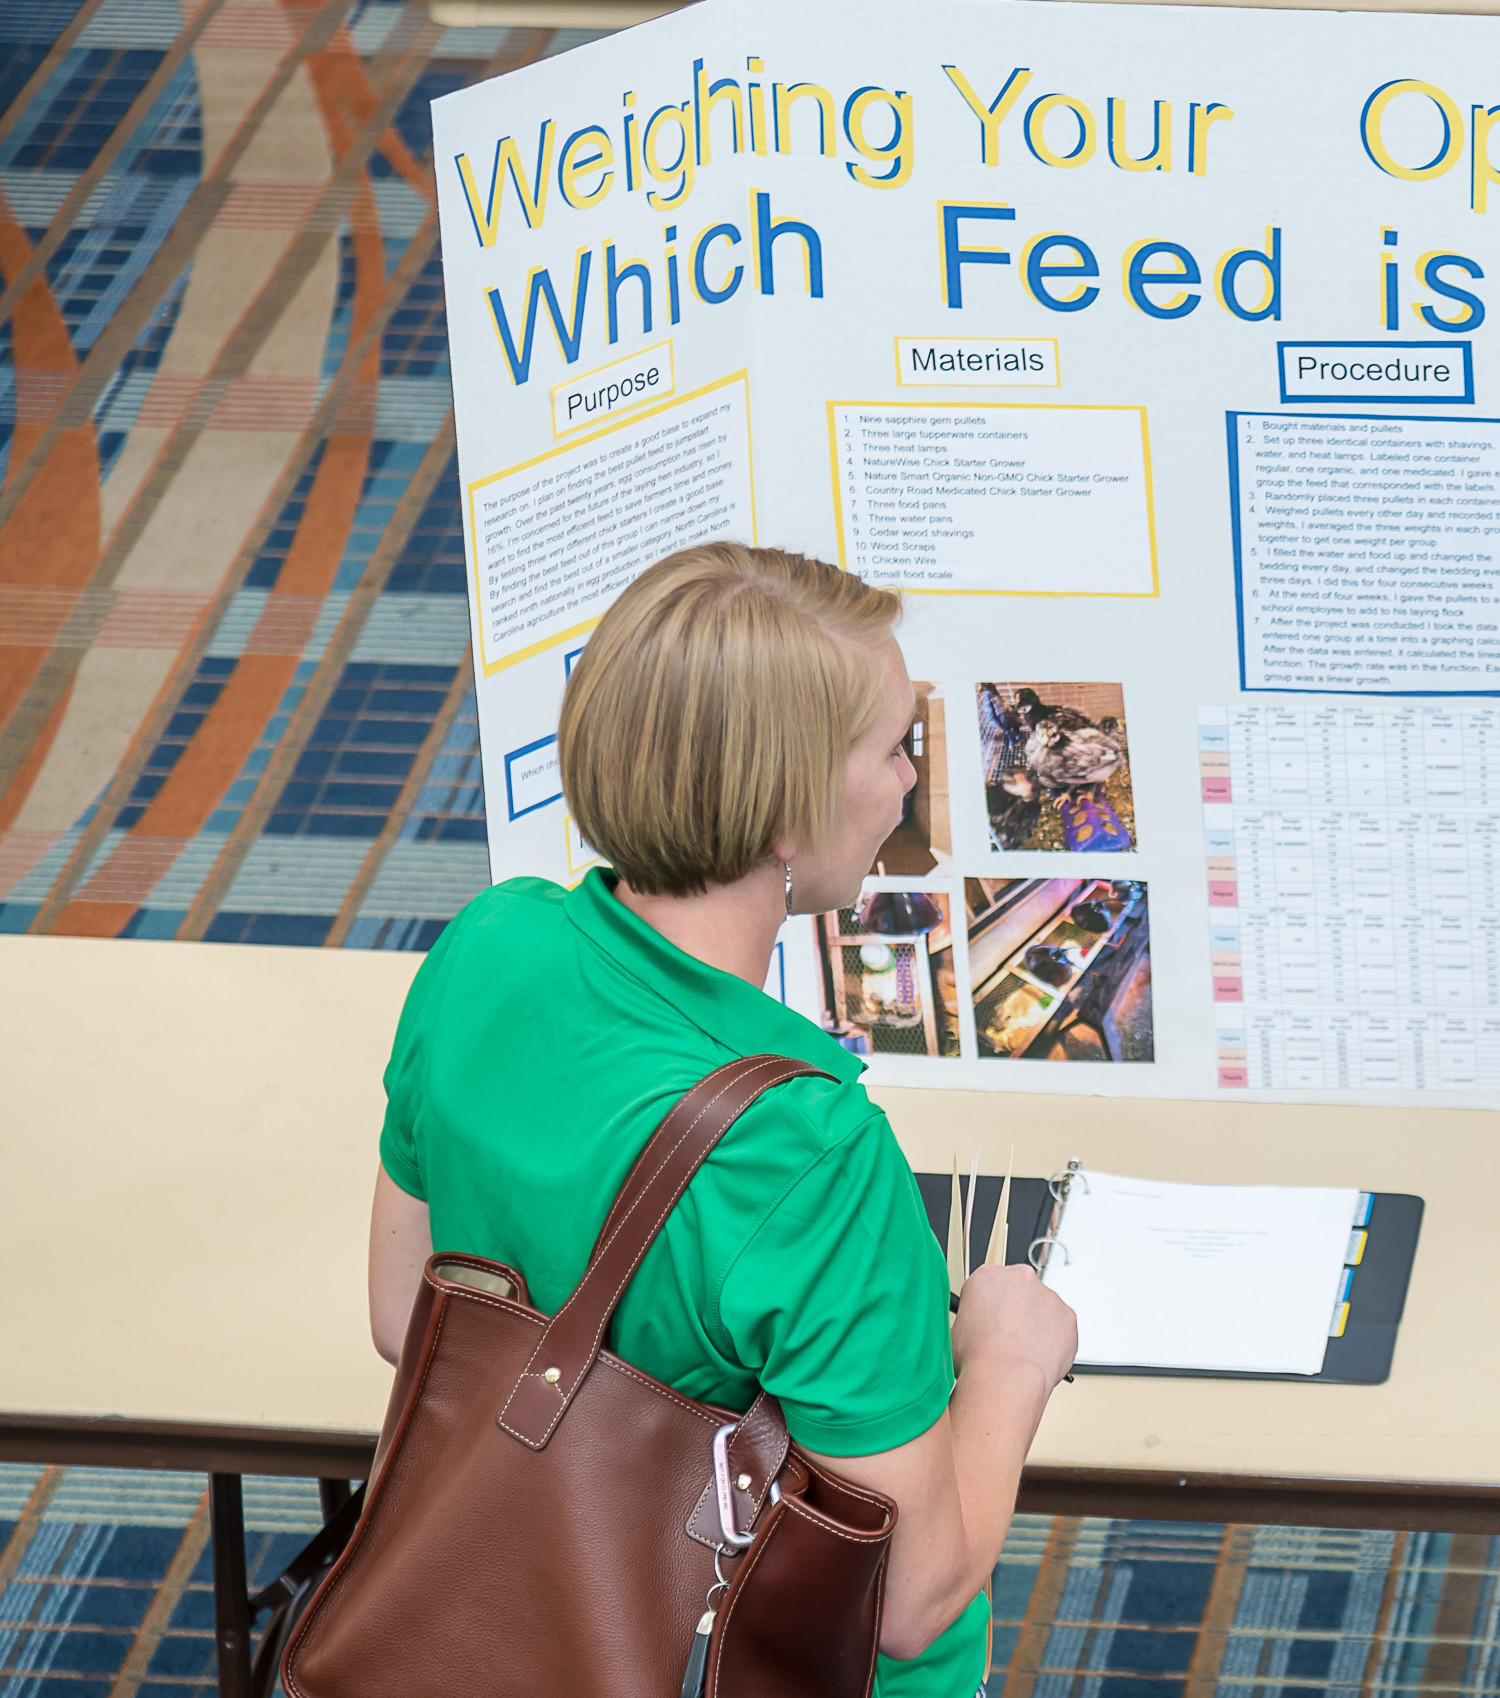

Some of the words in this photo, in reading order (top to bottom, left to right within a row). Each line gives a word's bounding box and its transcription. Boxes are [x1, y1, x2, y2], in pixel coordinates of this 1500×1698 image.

[454, 57, 913, 248] Weighing
[943, 65, 1234, 176] Your
[483, 188, 824, 385] Which
[937, 200, 1283, 321] Feed
[1379, 226, 1487, 333] is
[912, 348, 1045, 373] Materials
[1297, 356, 1451, 383] Procedure
[568, 367, 660, 420] Purpose
[859, 415, 882, 424] Nine
[884, 415, 927, 426] sapphire
[929, 417, 951, 426] gem
[953, 416, 986, 426] pullets
[1262, 420, 1298, 432] Bought
[1300, 422, 1346, 432] materials
[1348, 423, 1368, 432] and
[1370, 424, 1403, 434] pullets
[860, 428, 889, 438] Three
[892, 429, 917, 440] large
[919, 430, 974, 440] tupperware
[976, 431, 1028, 439] containers
[1262, 434, 1280, 444] Set
[1282, 437, 1295, 446] up
[1297, 436, 1323, 445] three
[1326, 437, 1368, 446] identical
[1370, 439, 1422, 448] containers
[1424, 440, 1445, 448] with
[861, 442, 890, 452] Three
[893, 443, 915, 452] heat
[916, 443, 947, 455] lamps
[482, 500, 498, 512] The
[499, 486, 530, 508] purpose
[541, 477, 554, 488] the
[555, 463, 581, 483] project
[582, 458, 598, 470] was
[608, 444, 632, 459] create
[640, 430, 660, 448] good
[661, 424, 680, 437] base
[690, 406, 718, 425] expand
[863, 457, 920, 466] NatureWise
[922, 457, 950, 467] Chick
[953, 458, 986, 467] Starter
[988, 458, 1026, 468] Grower
[1287, 450, 1306, 459] and
[1308, 450, 1331, 459] heat
[1369, 452, 1410, 462] Labeled
[1412, 454, 1432, 462] one
[1433, 454, 1480, 463] container
[483, 507, 517, 527] research
[537, 491, 554, 506] plan
[566, 475, 592, 491] finding
[593, 470, 606, 480] the
[607, 460, 624, 475] best
[625, 451, 646, 469] pullet
[647, 443, 664, 458] feed
[674, 425, 709, 449] jumpstart
[864, 471, 897, 480] Nature
[899, 471, 929, 480] Smart
[931, 471, 971, 483] Organic
[973, 472, 1024, 482] Non-GMO
[1026, 472, 1054, 482] Chick
[1056, 473, 1090, 482] Starter
[1092, 473, 1129, 483] Grower
[1359, 466, 1379, 475] and
[1466, 470, 1492, 479] gave
[865, 485, 904, 496] Country
[906, 485, 933, 495] Road
[935, 486, 986, 495] Medicated
[988, 486, 1016, 495] Chick
[1019, 486, 1053, 496] Starter
[1055, 487, 1092, 496] Grower
[866, 499, 896, 509] Three
[897, 499, 920, 509] food
[922, 501, 946, 510] pans
[867, 512, 897, 523] Three
[898, 514, 926, 523] water
[928, 515, 953, 525] pans
[868, 527, 899, 536] Cedar
[901, 528, 928, 537] wood
[930, 528, 974, 540] shavings
[869, 541, 899, 551] Wood
[901, 541, 936, 553] Scraps
[871, 554, 911, 565] Chicken
[913, 555, 937, 565] Wire
[872, 569, 901, 579] Small
[902, 569, 925, 579] food
[926, 570, 953, 579] scale
[520, 764, 545, 781] Which
